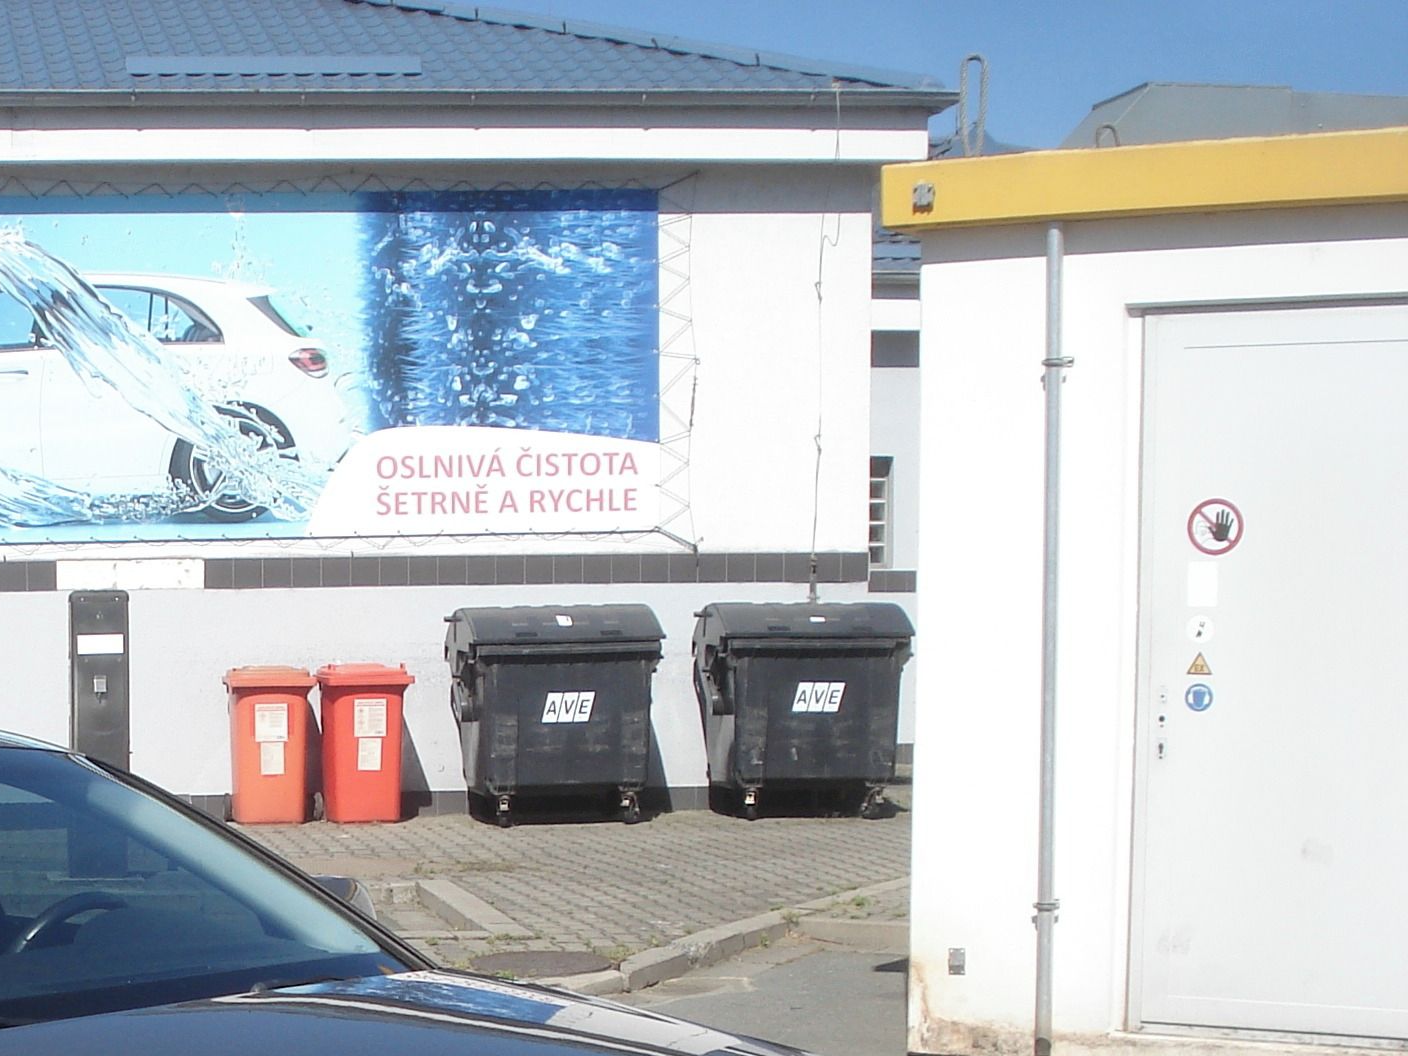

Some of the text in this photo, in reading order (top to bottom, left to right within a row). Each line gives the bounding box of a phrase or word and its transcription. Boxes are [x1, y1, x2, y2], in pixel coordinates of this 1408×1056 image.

[376, 446, 638, 480] OSLNIVÁ ČISTOTA
[376, 484, 638, 516] ŠETRNĚ A RYCHLE
[545, 699, 591, 716] AVE
[796, 689, 841, 705] AVE
